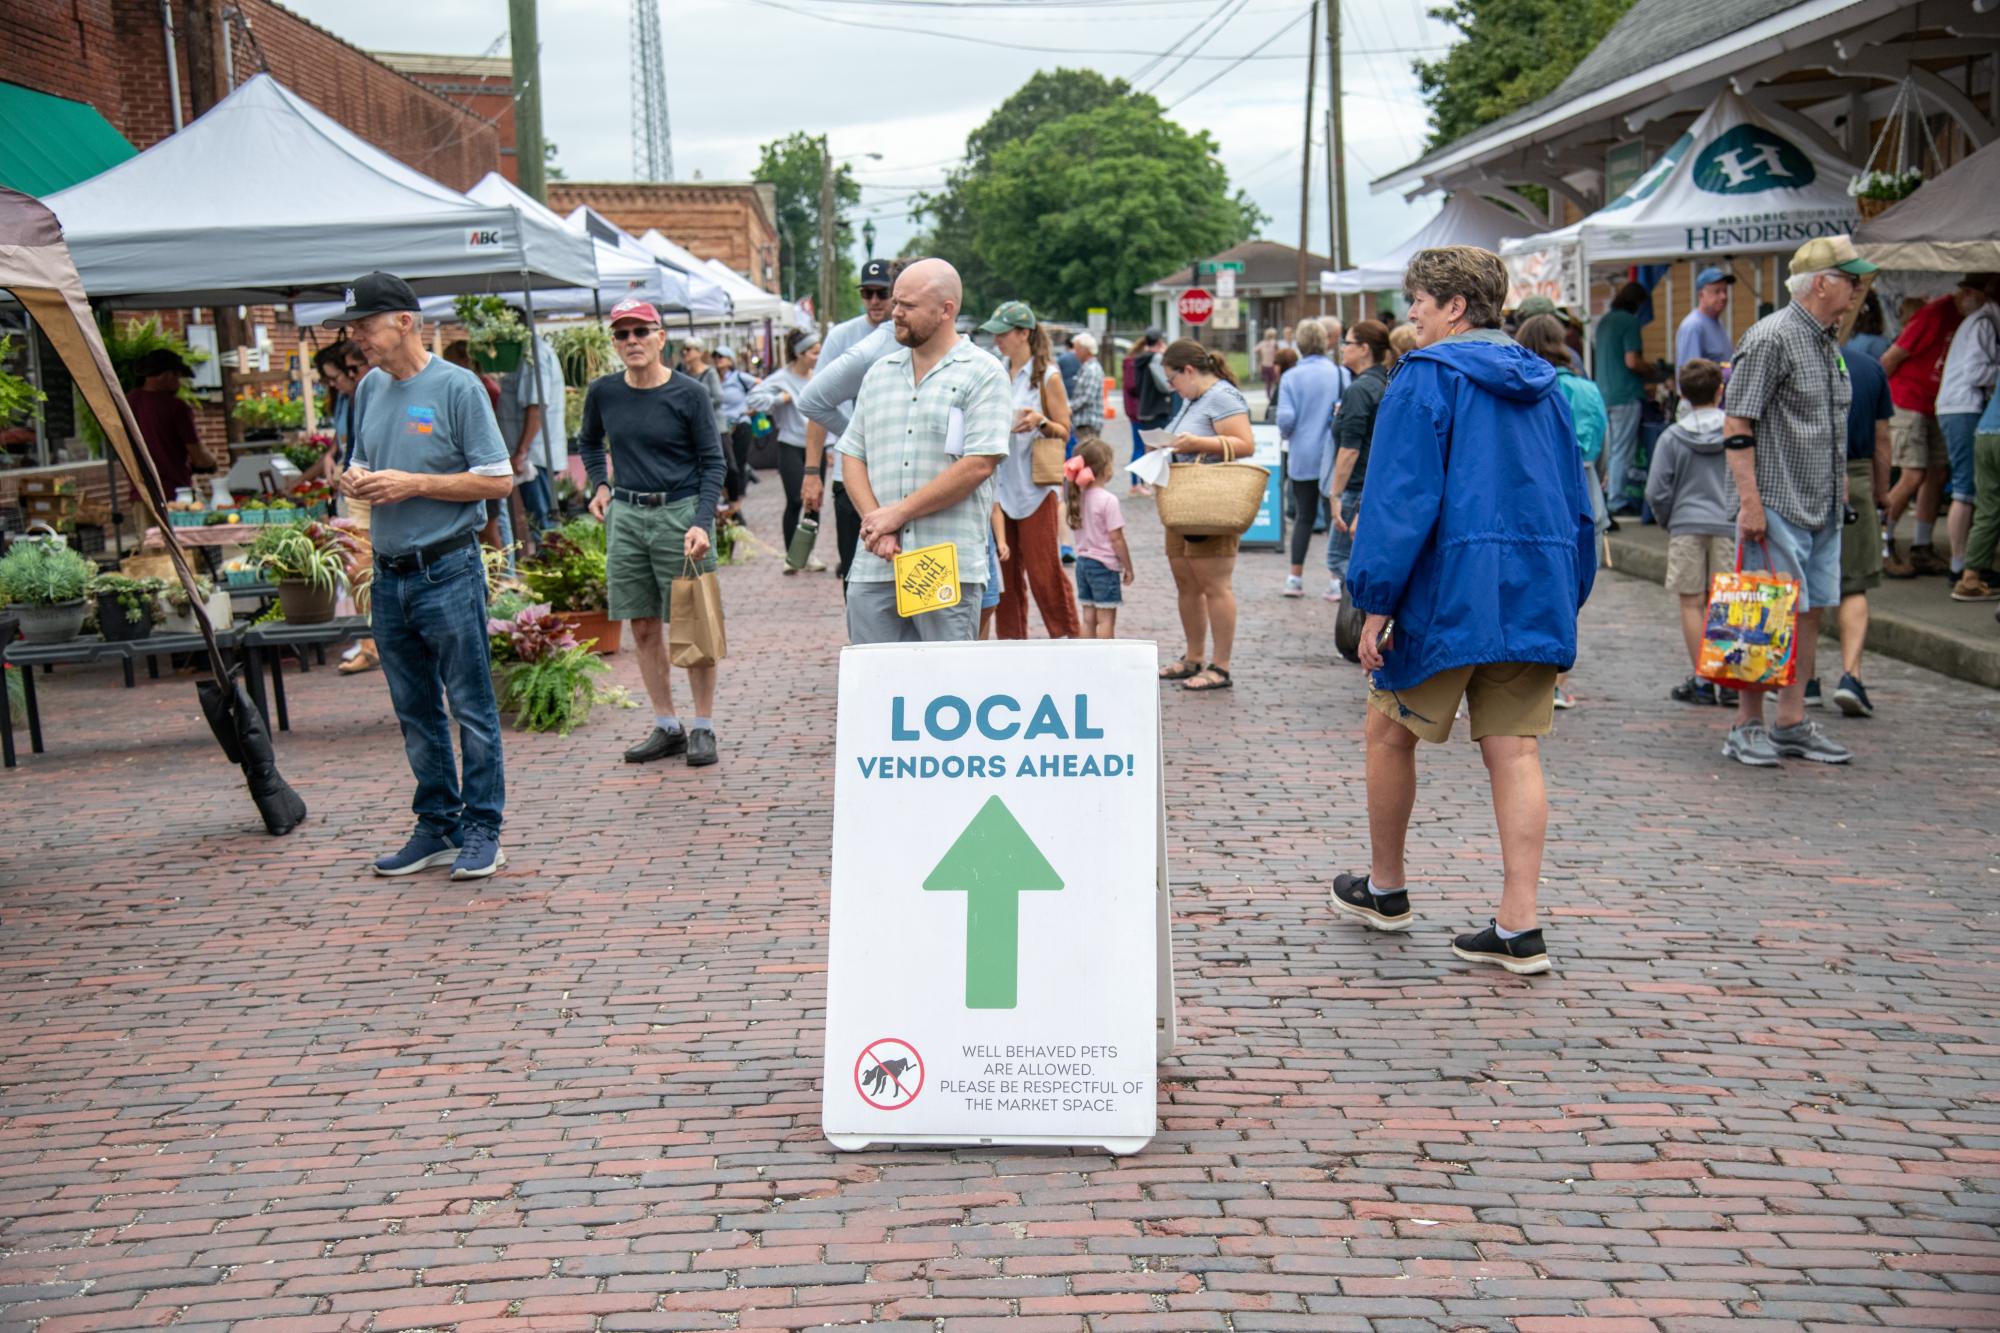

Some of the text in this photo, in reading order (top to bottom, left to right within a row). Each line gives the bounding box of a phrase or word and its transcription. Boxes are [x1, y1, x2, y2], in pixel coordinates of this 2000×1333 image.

[1718, 212, 1788, 226] HISTORIC
[469, 231, 499, 246] ABC
[1686, 218, 1858, 250] HENDERSONV
[868, 263, 880, 275] C
[1179, 298, 1212, 314] STOP
[902, 554, 935, 592] TRAIN
[912, 561, 946, 599] THINK
[892, 694, 1104, 741] LOCAL
[857, 754, 1134, 779] VENDORS AHEAD!
[962, 1045, 1118, 1058] WELL BEHAVED PETS
[983, 1063, 1095, 1076] ARE ALLOWED.
[940, 1080, 1144, 1094] PLEASE BE RESPECTFUL OF
[965, 1098, 1118, 1112] THE MARKET SPACE.
